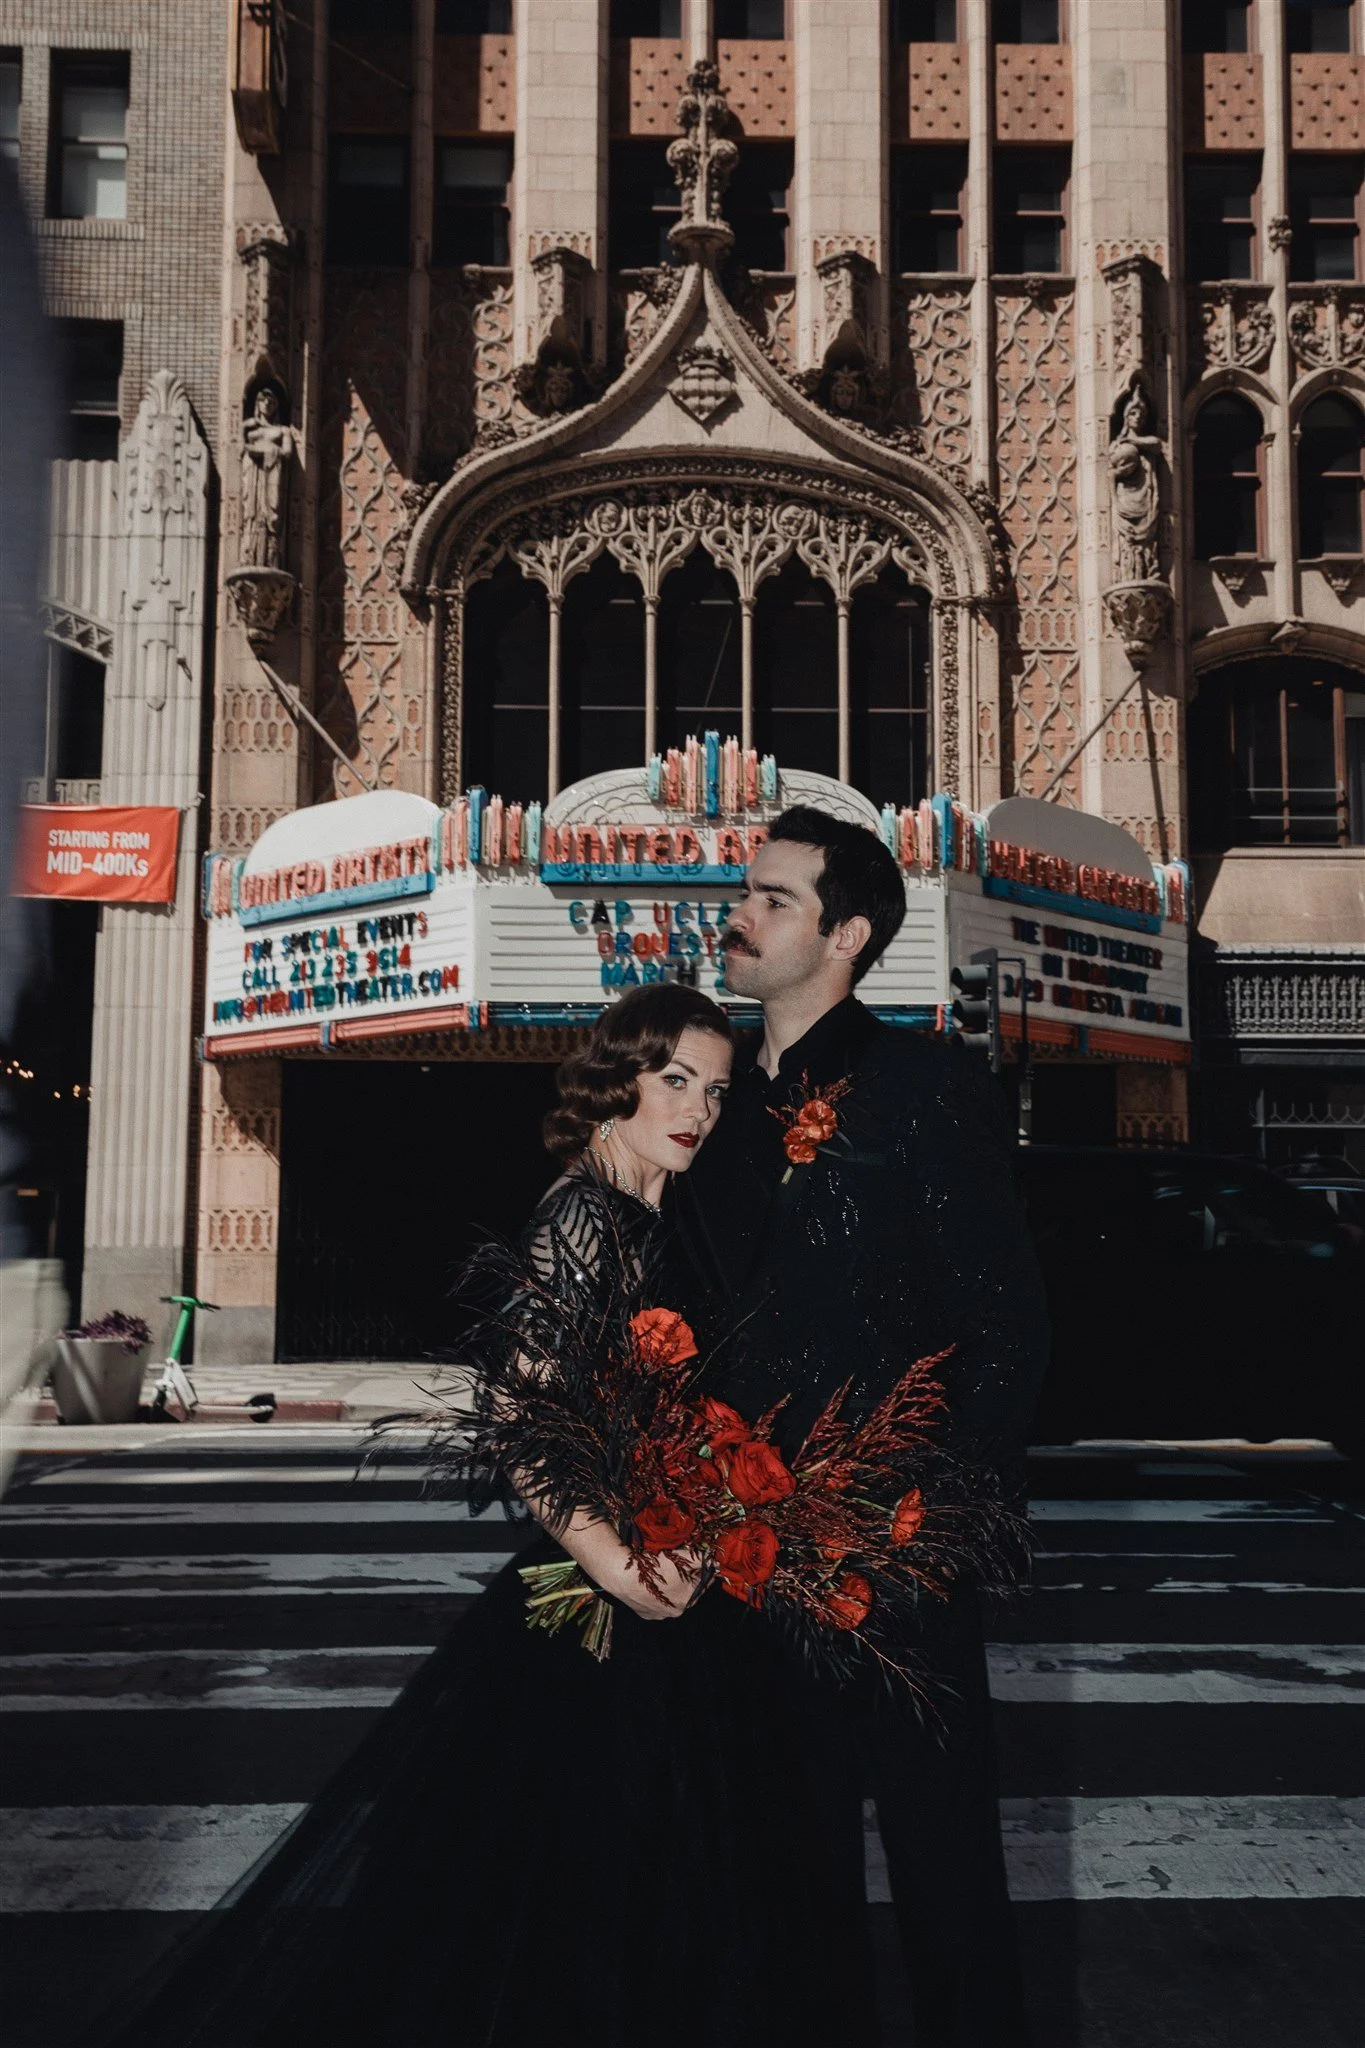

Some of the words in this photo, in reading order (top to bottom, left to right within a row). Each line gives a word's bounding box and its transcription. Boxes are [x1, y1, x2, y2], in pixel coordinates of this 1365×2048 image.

[48, 829, 110, 848] STARTING
[112, 831, 150, 849] FROM
[544, 825, 701, 864] UNITED
[47, 851, 149, 877] MID-400Ks
[240, 859, 326, 909] UNITED
[568, 900, 633, 925] CAP
[281, 925, 350, 961] SPECIAL
[357, 911, 429, 946] EVENTS
[597, 932, 725, 957] ORQUEST
[242, 963, 280, 993] CALL
